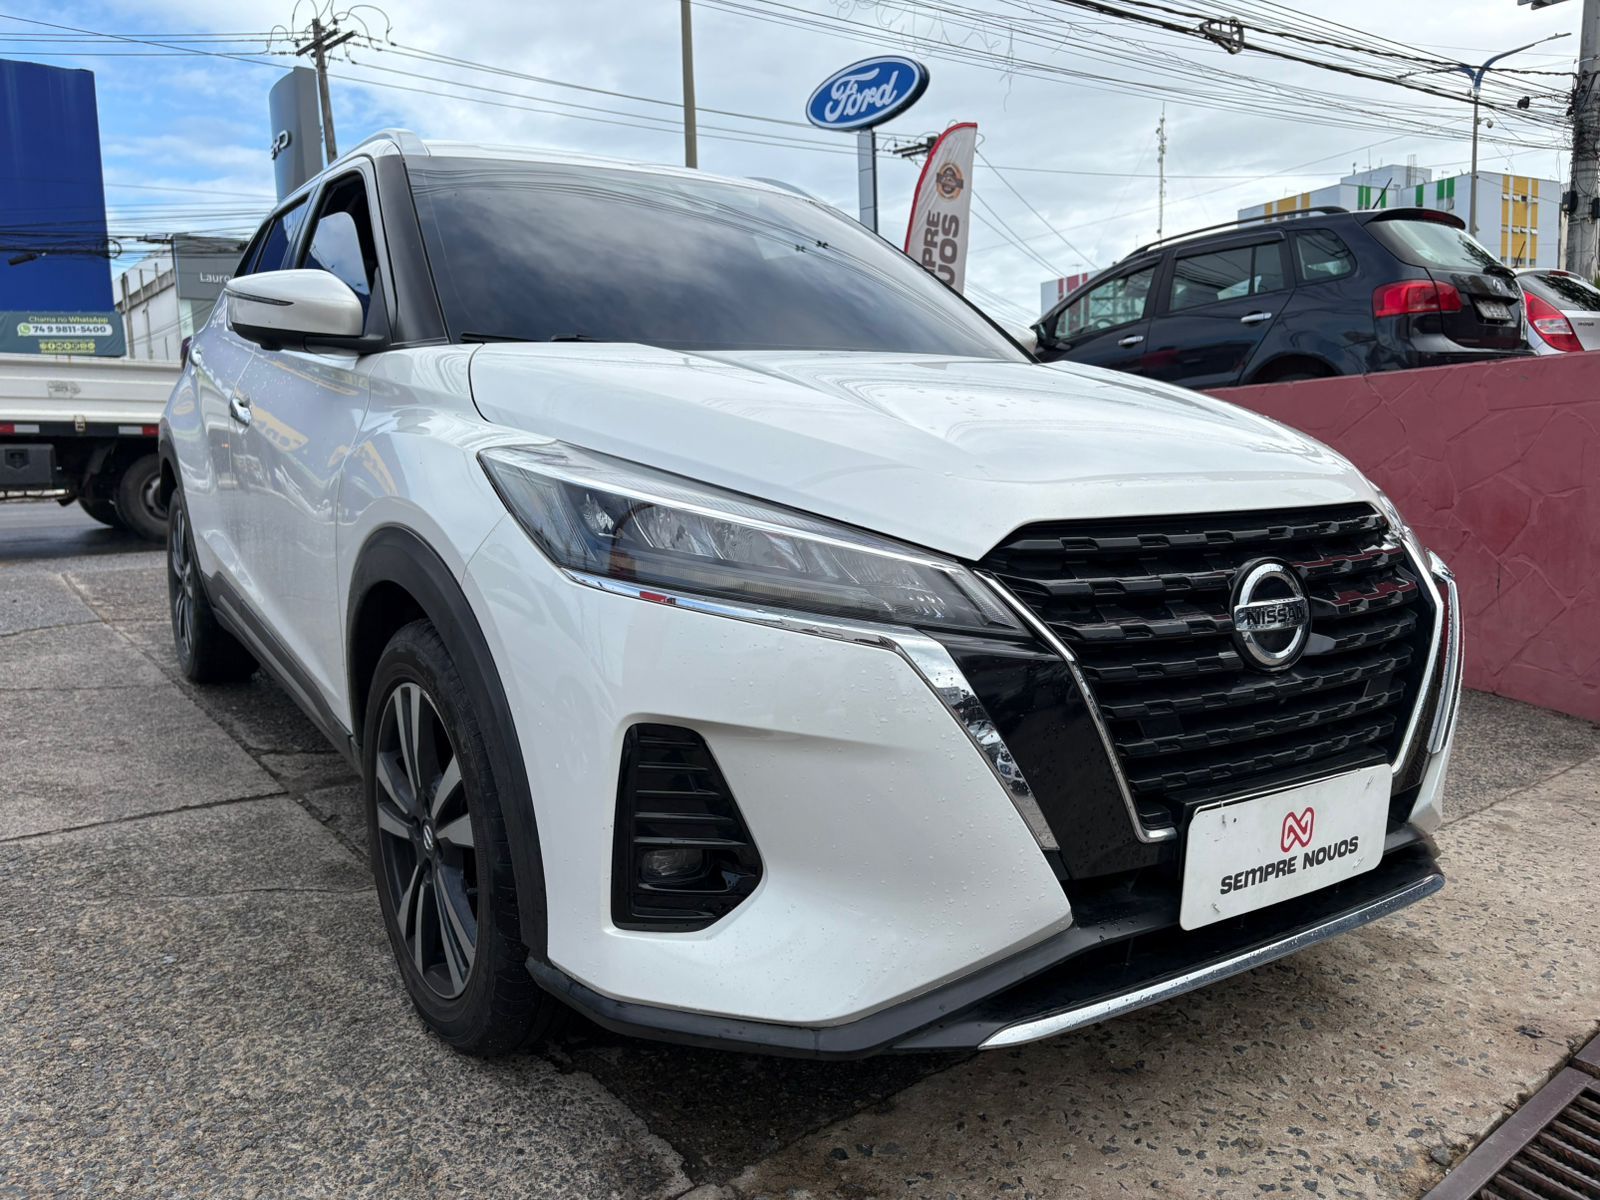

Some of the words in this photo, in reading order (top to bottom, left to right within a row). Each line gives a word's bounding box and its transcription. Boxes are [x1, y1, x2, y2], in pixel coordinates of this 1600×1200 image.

[824, 67, 900, 122] Ford
[200, 272, 231, 283] Lauro
[68, 316, 109, 324] WhatsApp
[32, 325, 45, 333] 74
[47, 325, 54, 333] 9
[55, 325, 107, 333] 9811-5400
[1246, 606, 1305, 626] NISSAN
[1220, 855, 1297, 895] SEMPRE
